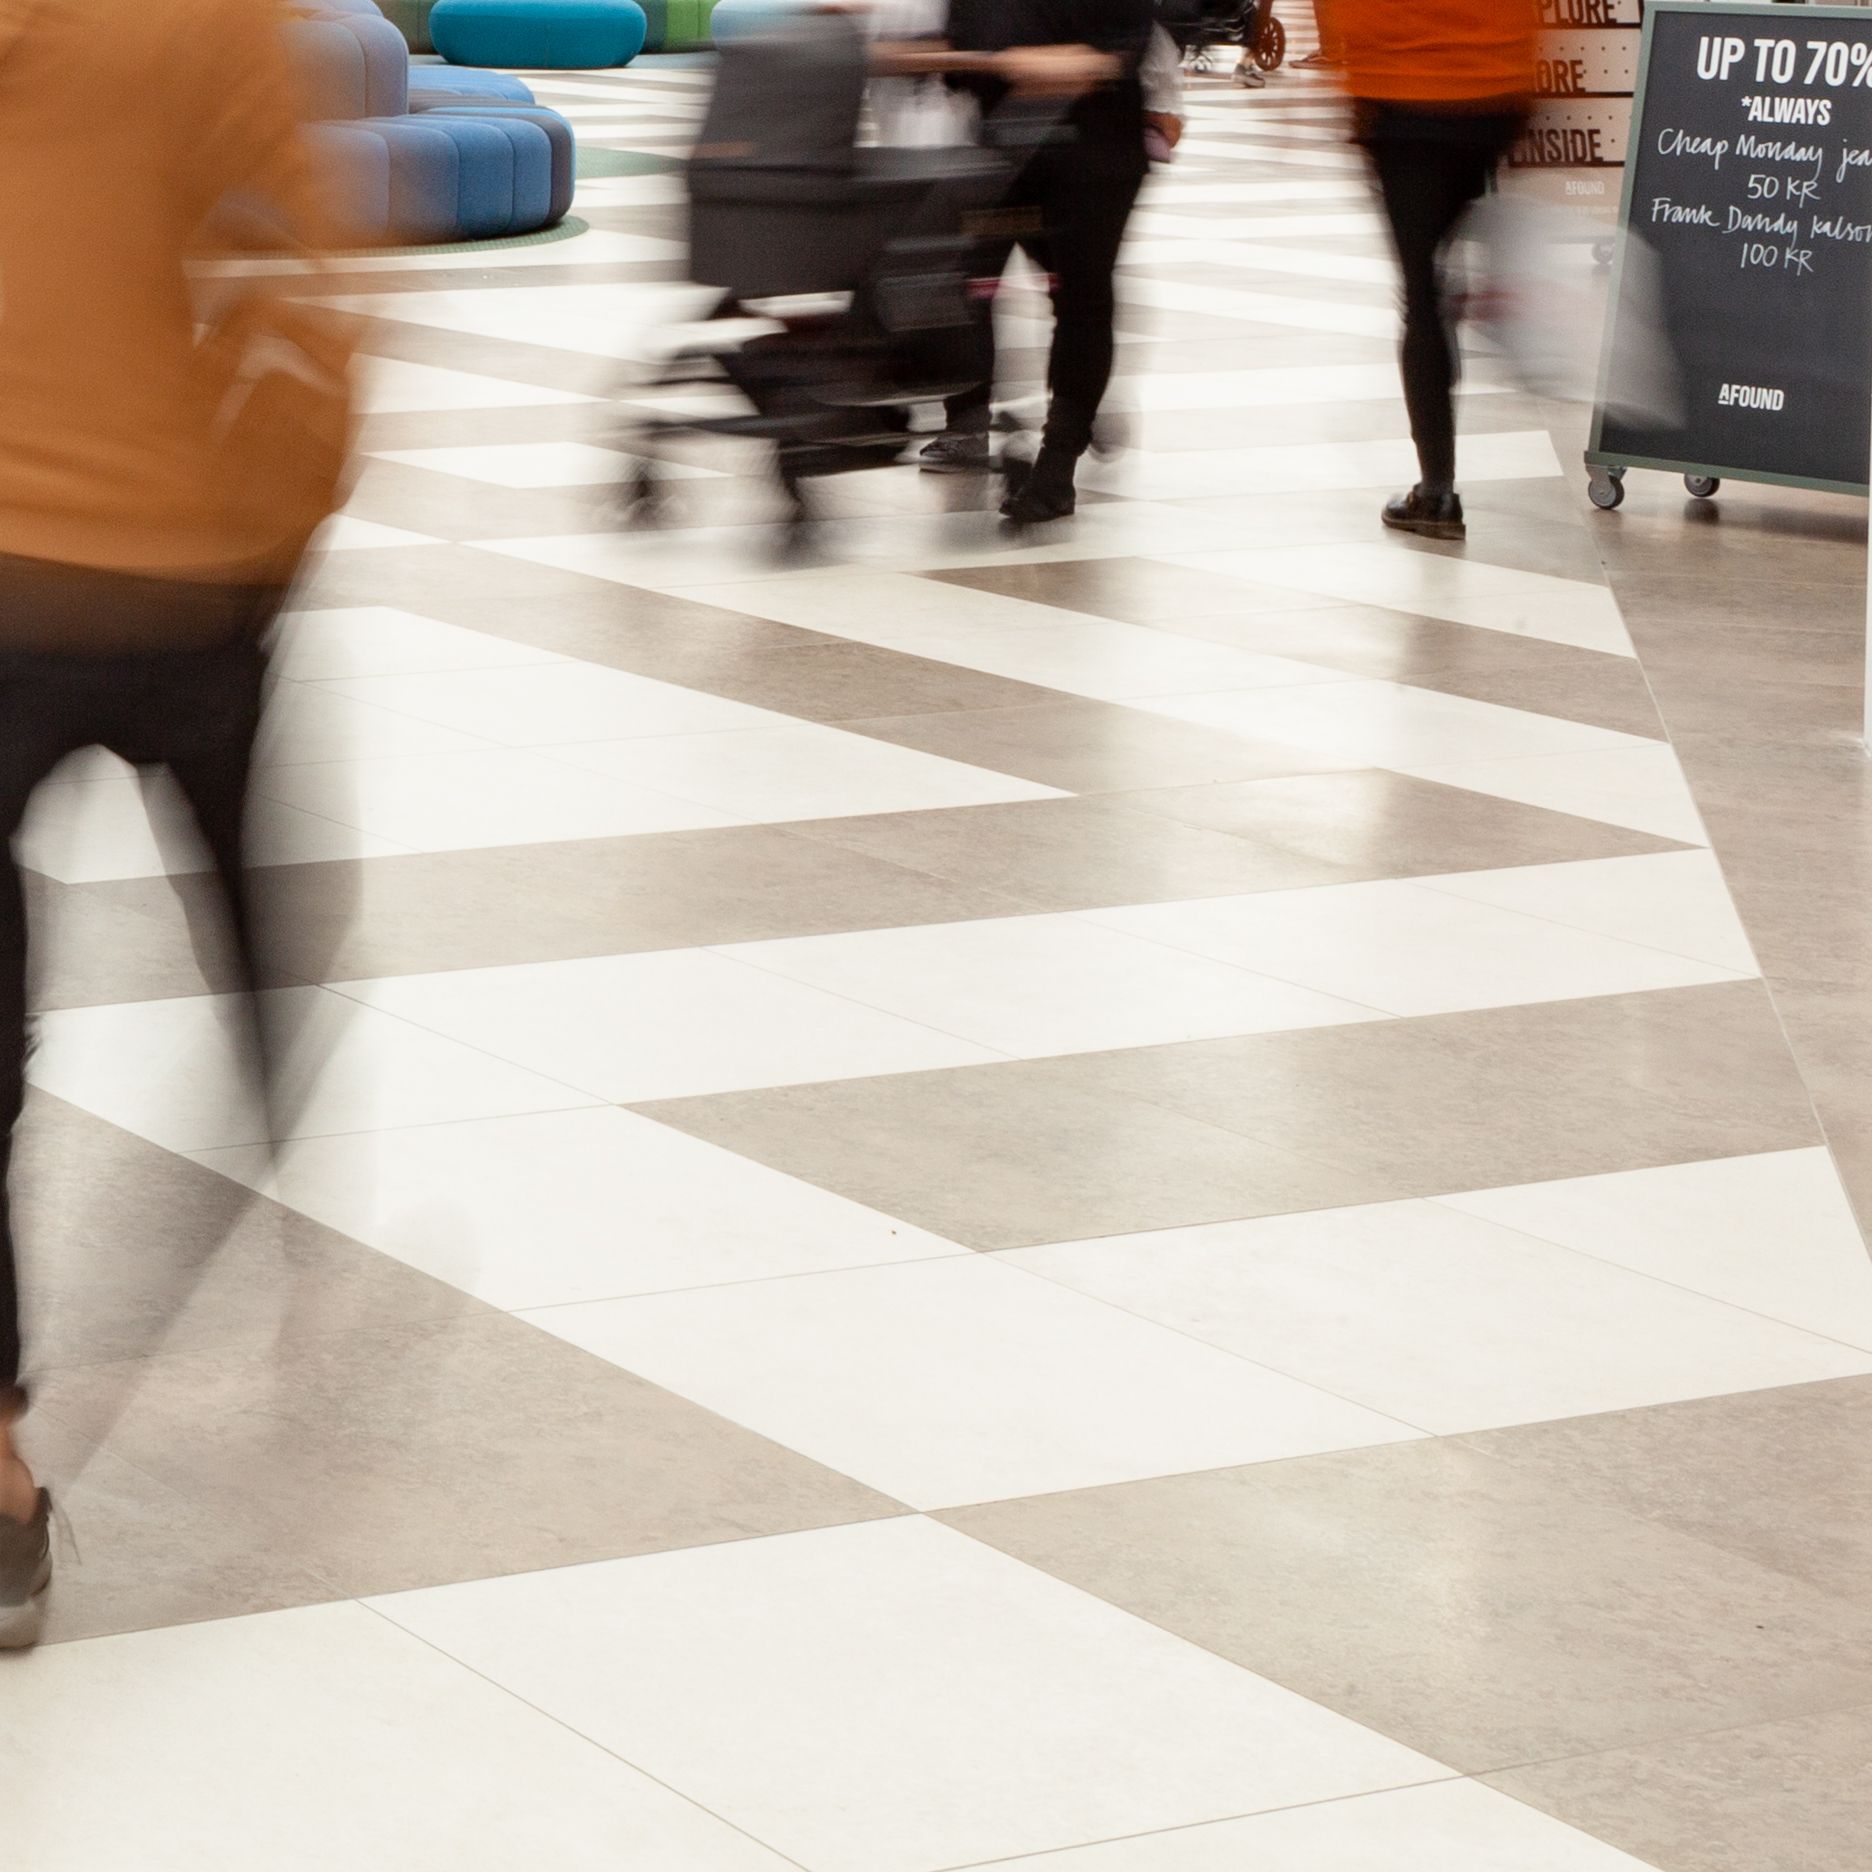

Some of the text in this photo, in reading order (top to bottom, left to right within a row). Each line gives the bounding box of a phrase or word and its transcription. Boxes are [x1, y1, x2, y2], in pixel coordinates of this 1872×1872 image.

[1534, 58, 1587, 93] ORE
[1696, 36, 1746, 80] UP
[1753, 39, 1797, 84] TO
[1658, 128, 1872, 184] Cheap Monday jea
[1565, 181, 1605, 196] AFOUND
[1747, 173, 1822, 209] 50 KR
[1651, 197, 1721, 228] Frank
[1722, 205, 1799, 250] Dandy
[1740, 242, 1814, 277] 100 KR
[1718, 383, 1785, 411] AFOUND
